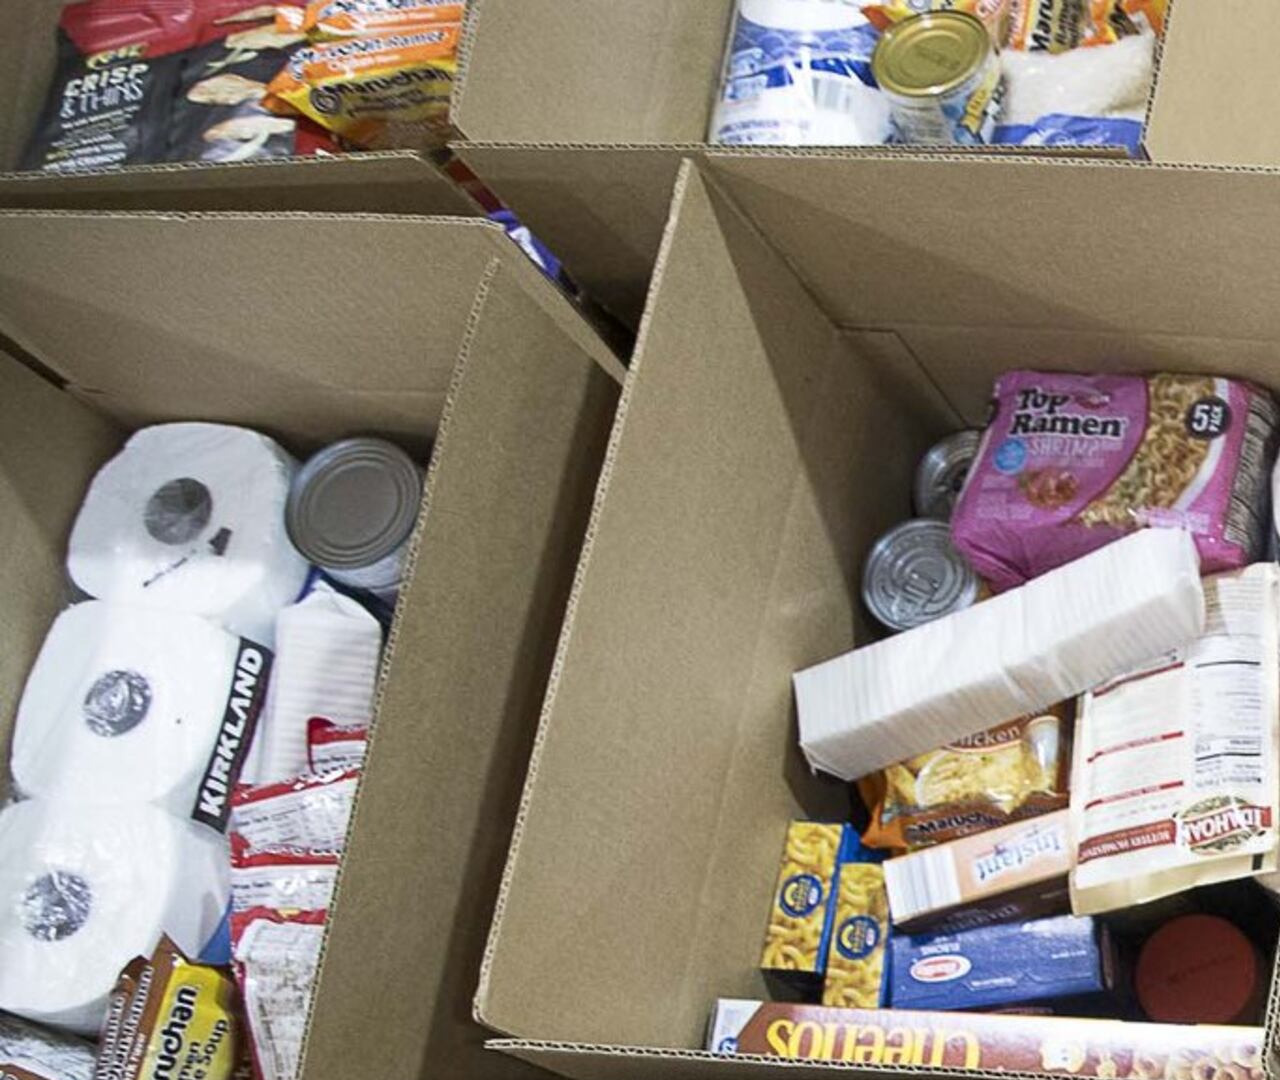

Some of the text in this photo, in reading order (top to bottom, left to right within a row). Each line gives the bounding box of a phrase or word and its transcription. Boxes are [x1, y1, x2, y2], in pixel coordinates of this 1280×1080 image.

[64, 64, 149, 97] CRISP
[1017, 389, 1071, 413] Top
[1010, 412, 1122, 437] Ramen
[1191, 404, 1209, 432] 5
[199, 647, 264, 817] KIRKLAND
[975, 828, 1062, 881] Instant
[203, 1020, 229, 1066] Soup
